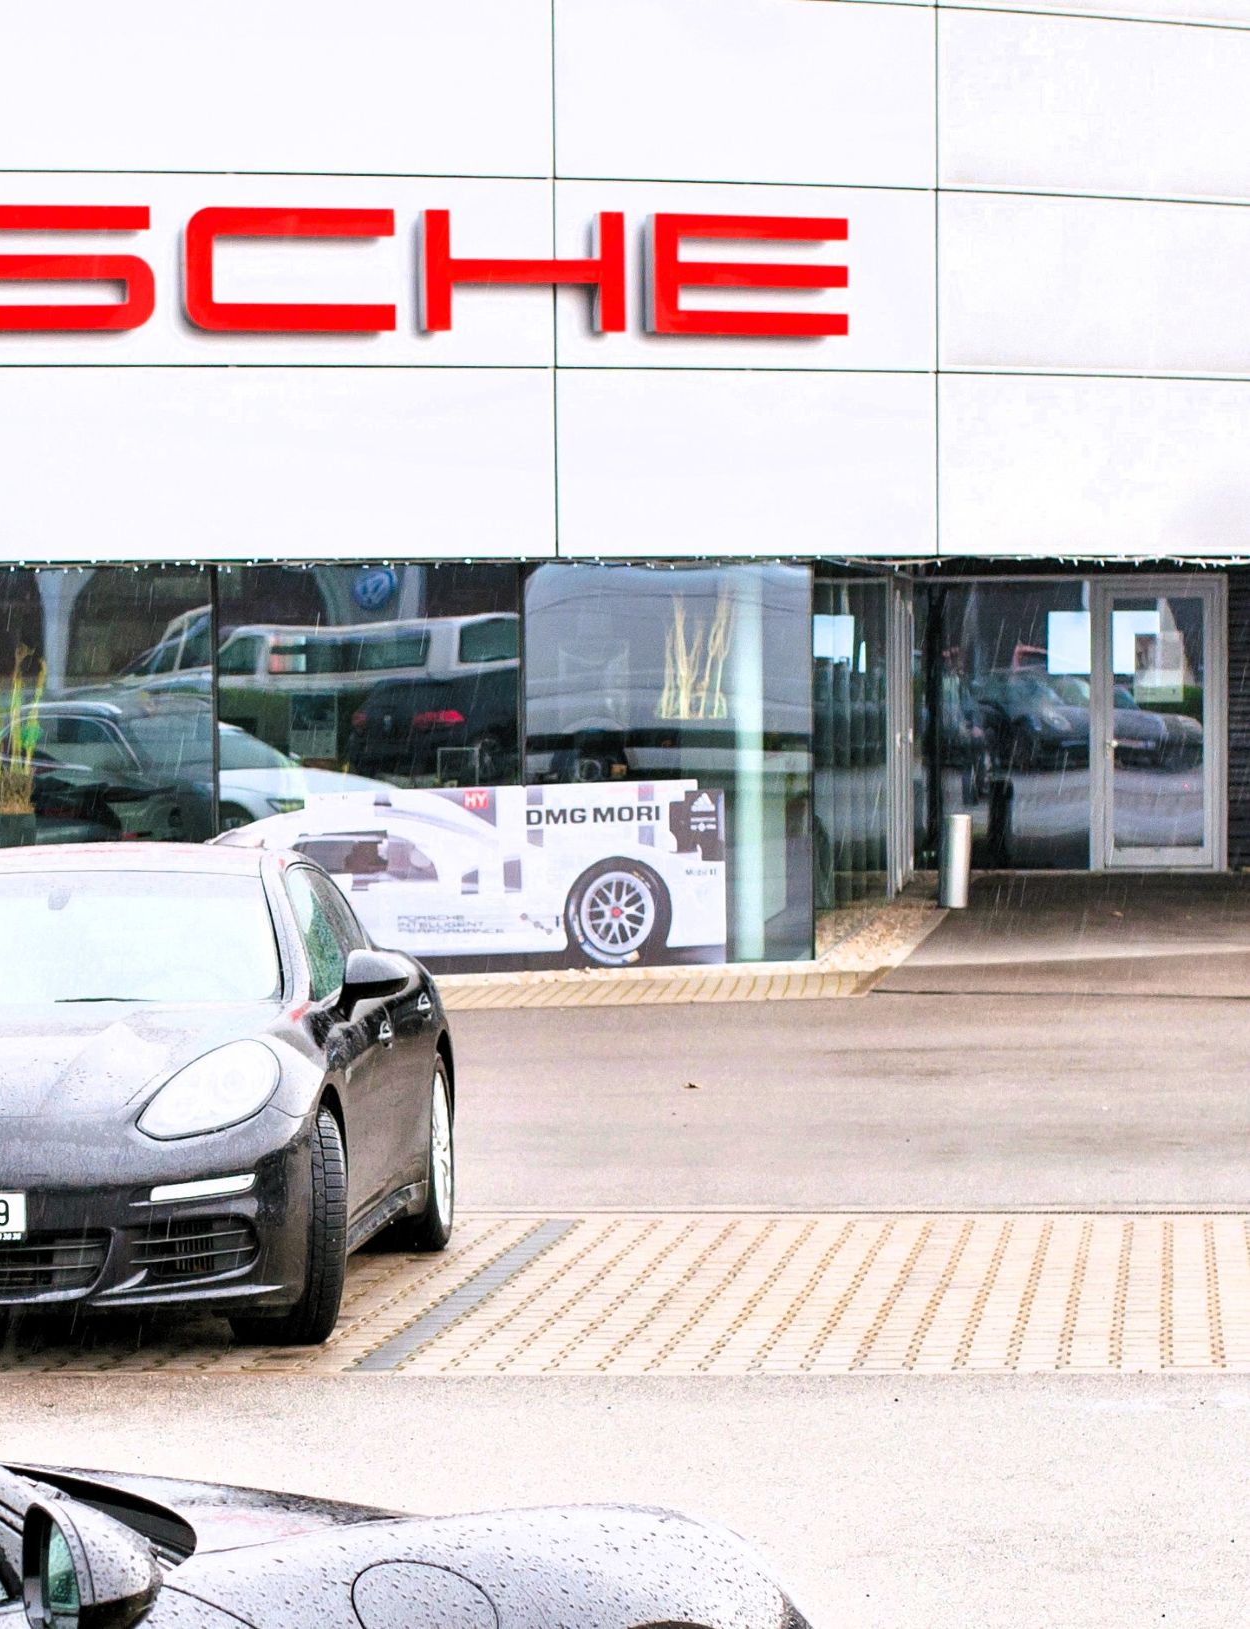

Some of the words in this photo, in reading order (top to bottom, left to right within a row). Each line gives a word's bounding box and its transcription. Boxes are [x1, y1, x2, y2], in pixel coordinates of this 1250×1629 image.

[464, 792, 488, 808] HY
[526, 808, 586, 825] DMG
[593, 806, 660, 823] MORI
